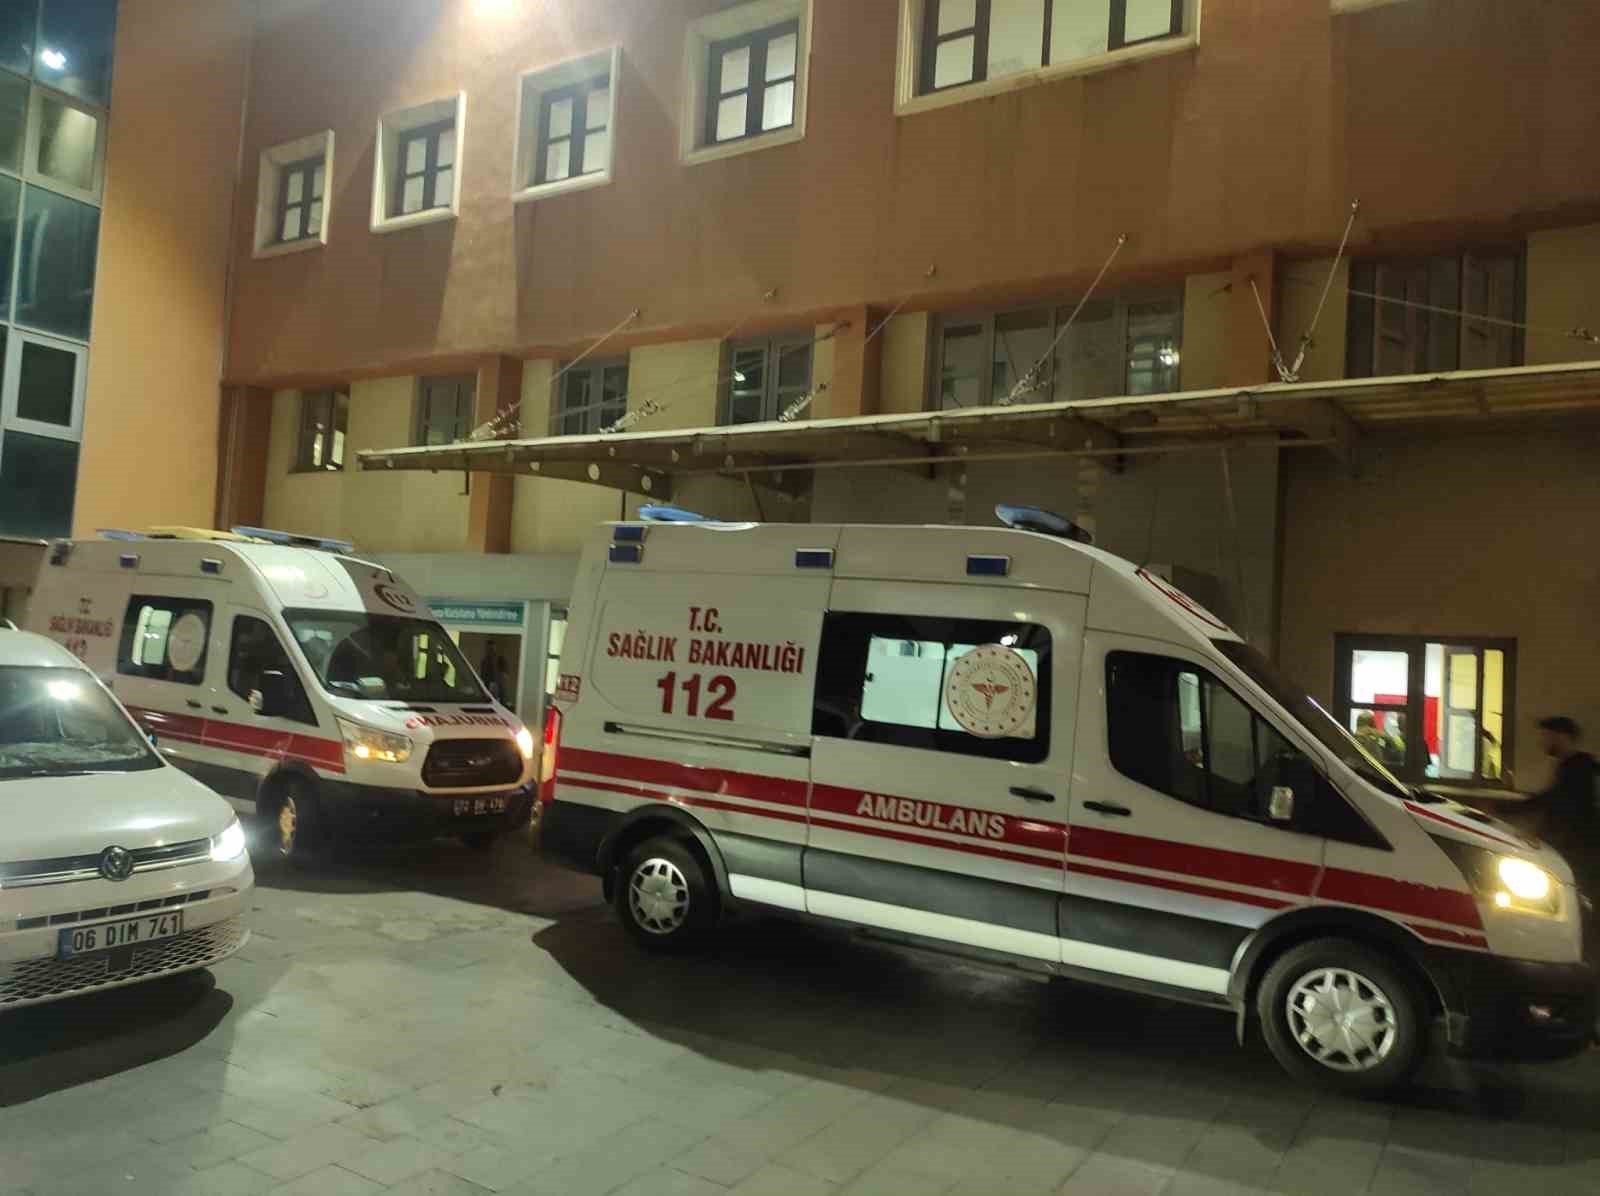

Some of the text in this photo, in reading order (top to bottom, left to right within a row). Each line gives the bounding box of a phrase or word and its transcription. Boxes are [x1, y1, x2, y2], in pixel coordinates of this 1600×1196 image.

[688, 607, 723, 633] T.C.
[607, 628, 805, 674] SAĞLIK BAKANLIĞI
[657, 671, 737, 721] 112
[856, 792, 1007, 839] AMBULANS
[73, 914, 178, 951] 06 DIM 741
